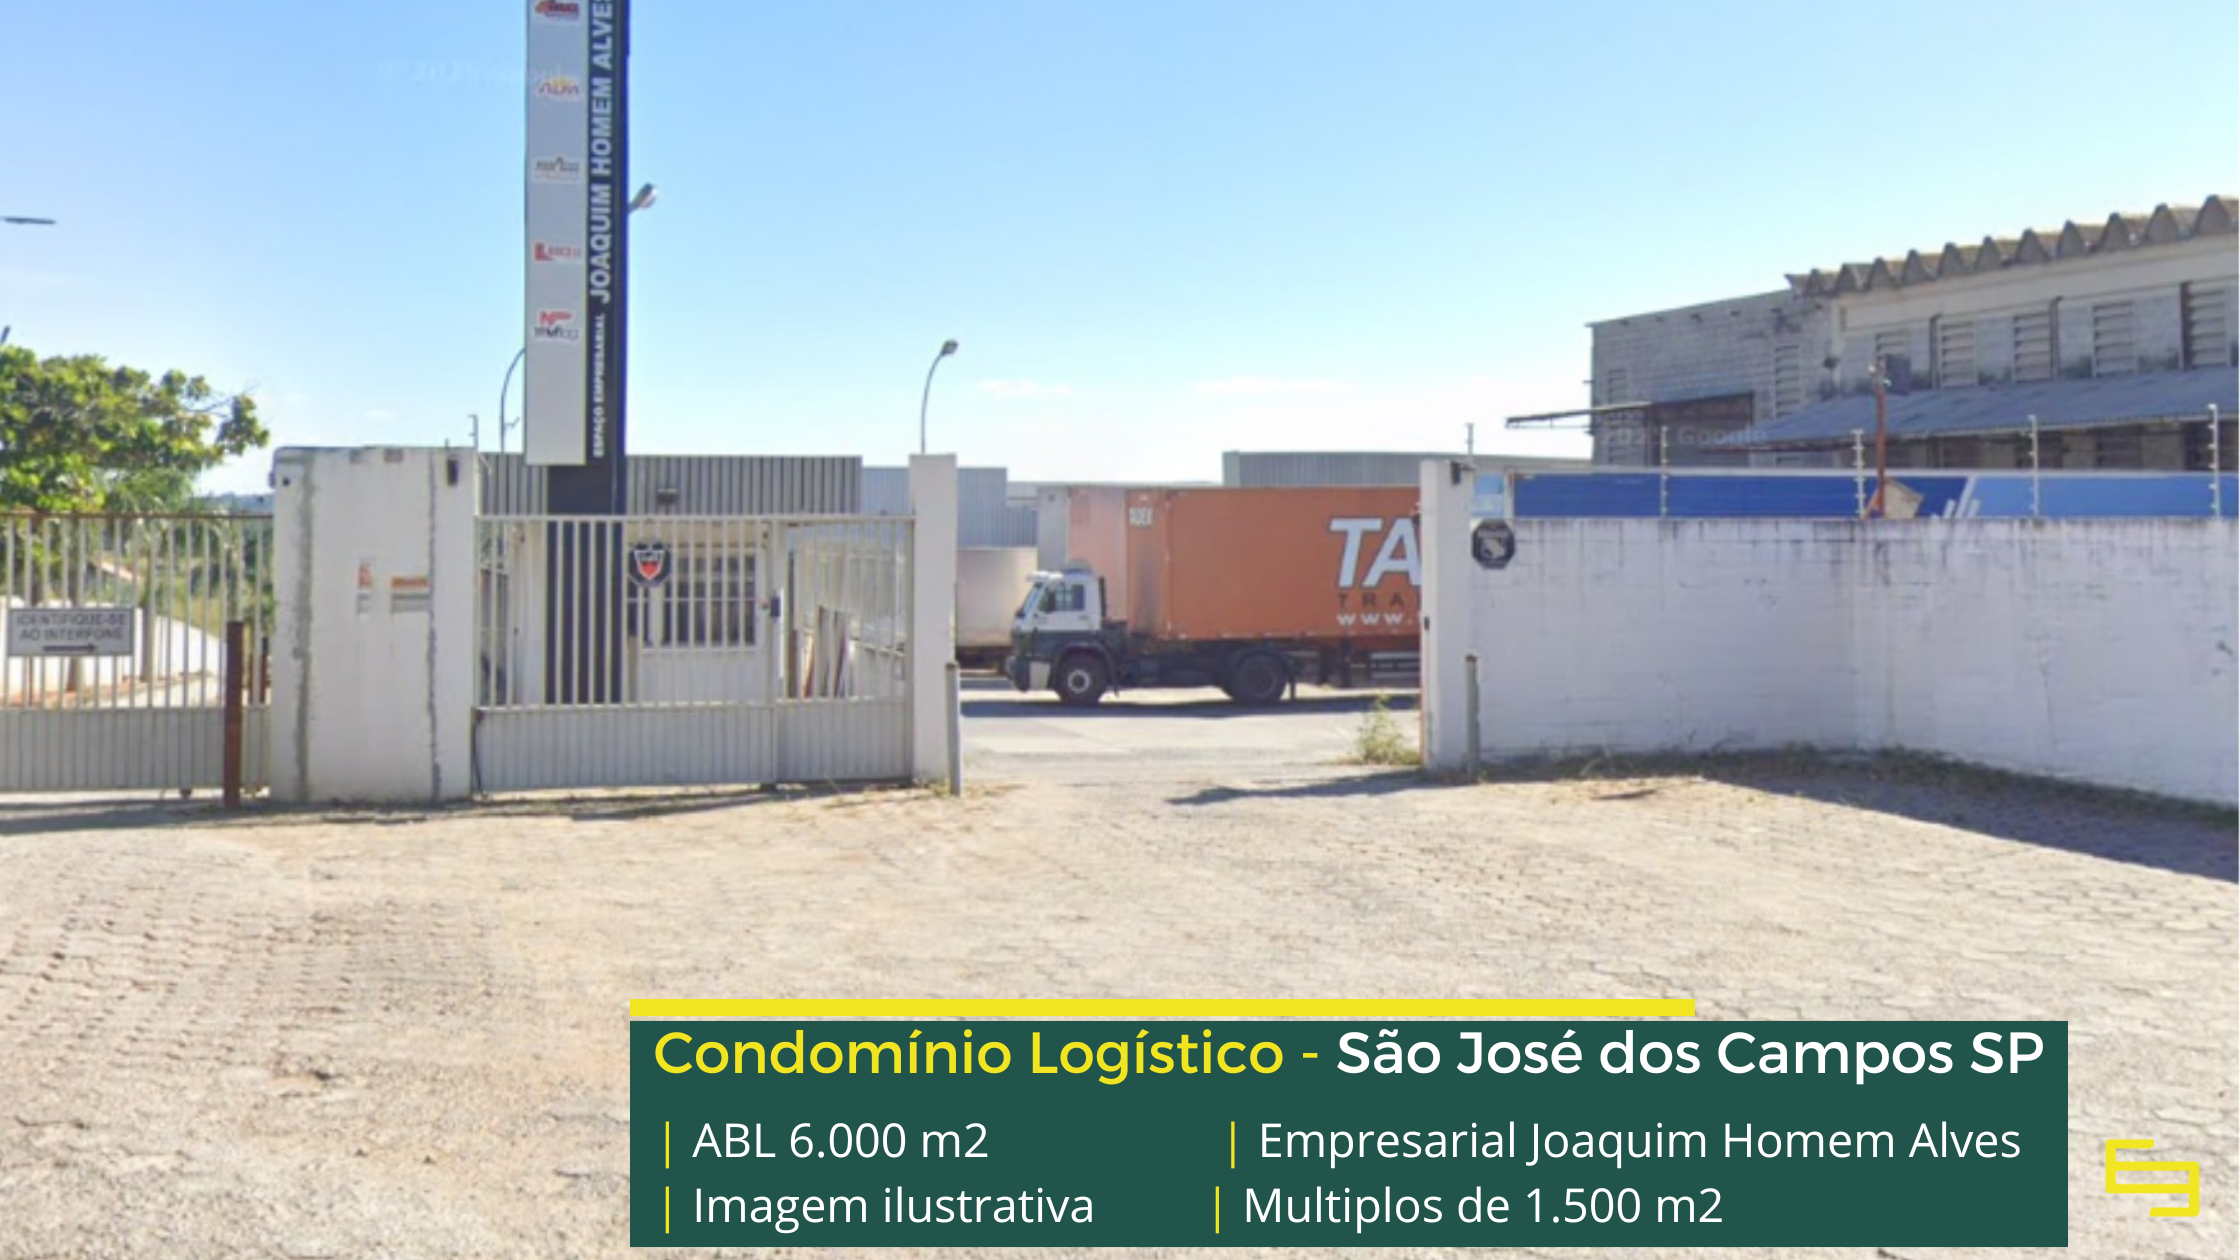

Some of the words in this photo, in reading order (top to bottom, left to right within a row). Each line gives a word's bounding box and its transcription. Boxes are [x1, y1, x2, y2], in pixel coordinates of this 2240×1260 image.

[591, 0, 613, 70] ALVE
[591, 77, 612, 175] HOMEM
[590, 184, 612, 304] JOAQUIM
[593, 313, 606, 403] EMPRESARIAL
[1328, 516, 1422, 589] TA
[16, 612, 127, 626] IDENTIFIQUE-SE
[20, 628, 41, 641] AO
[44, 627, 123, 641] INTERFONE
